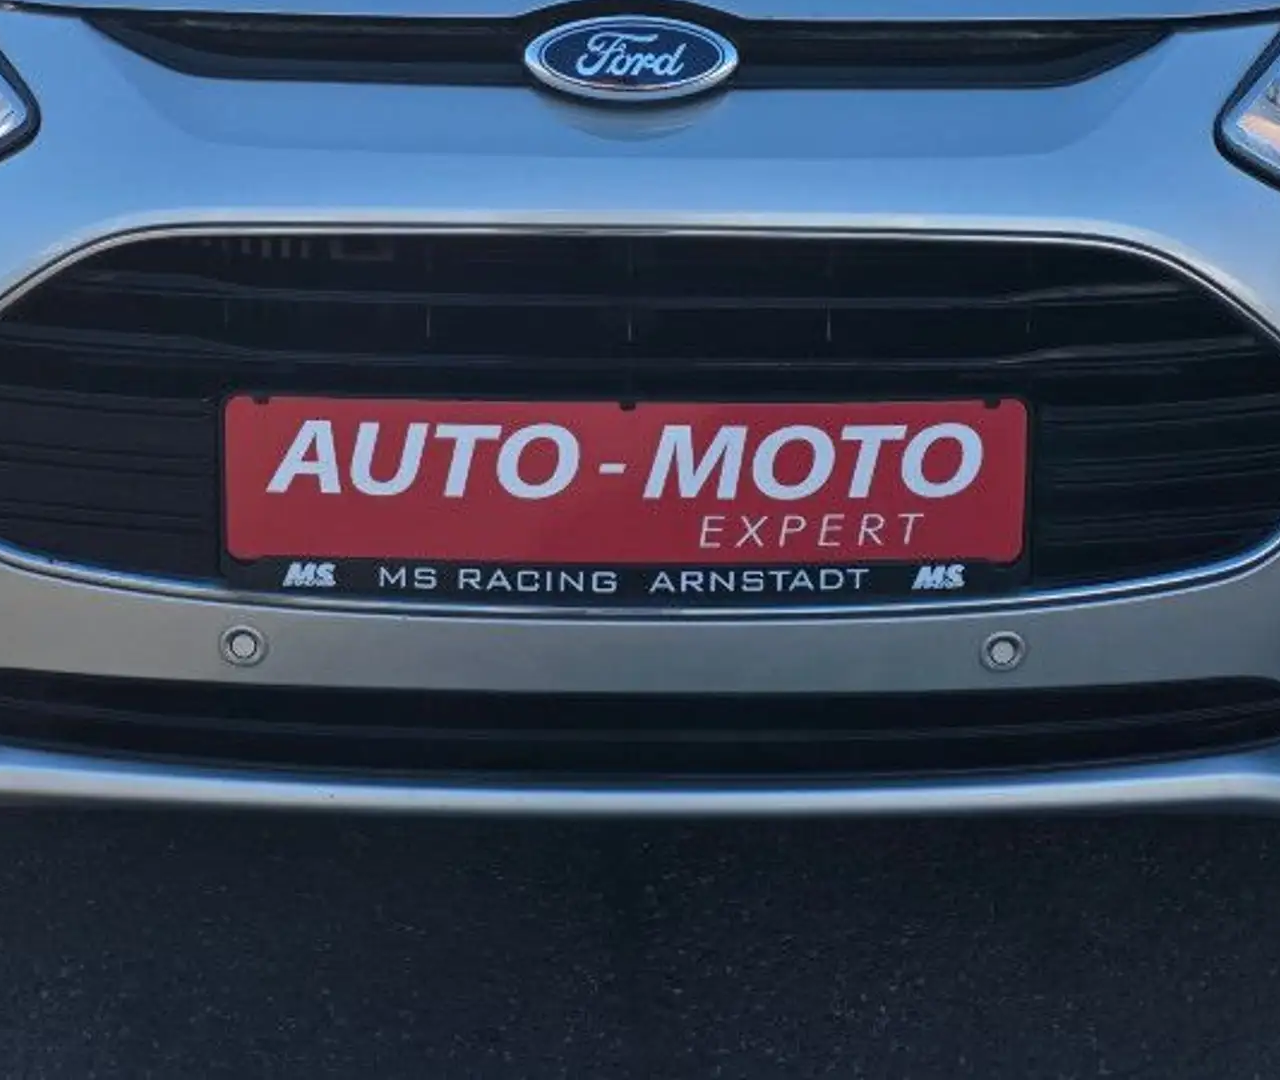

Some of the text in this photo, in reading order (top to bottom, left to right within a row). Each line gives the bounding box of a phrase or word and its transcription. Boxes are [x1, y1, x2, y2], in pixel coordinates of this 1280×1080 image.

[575, 31, 687, 76] Ford
[265, 419, 581, 500] AUTO
[642, 421, 984, 500] MOTO
[698, 512, 924, 549] EXPERT
[377, 566, 869, 593] MS RACING ARNSTADT
